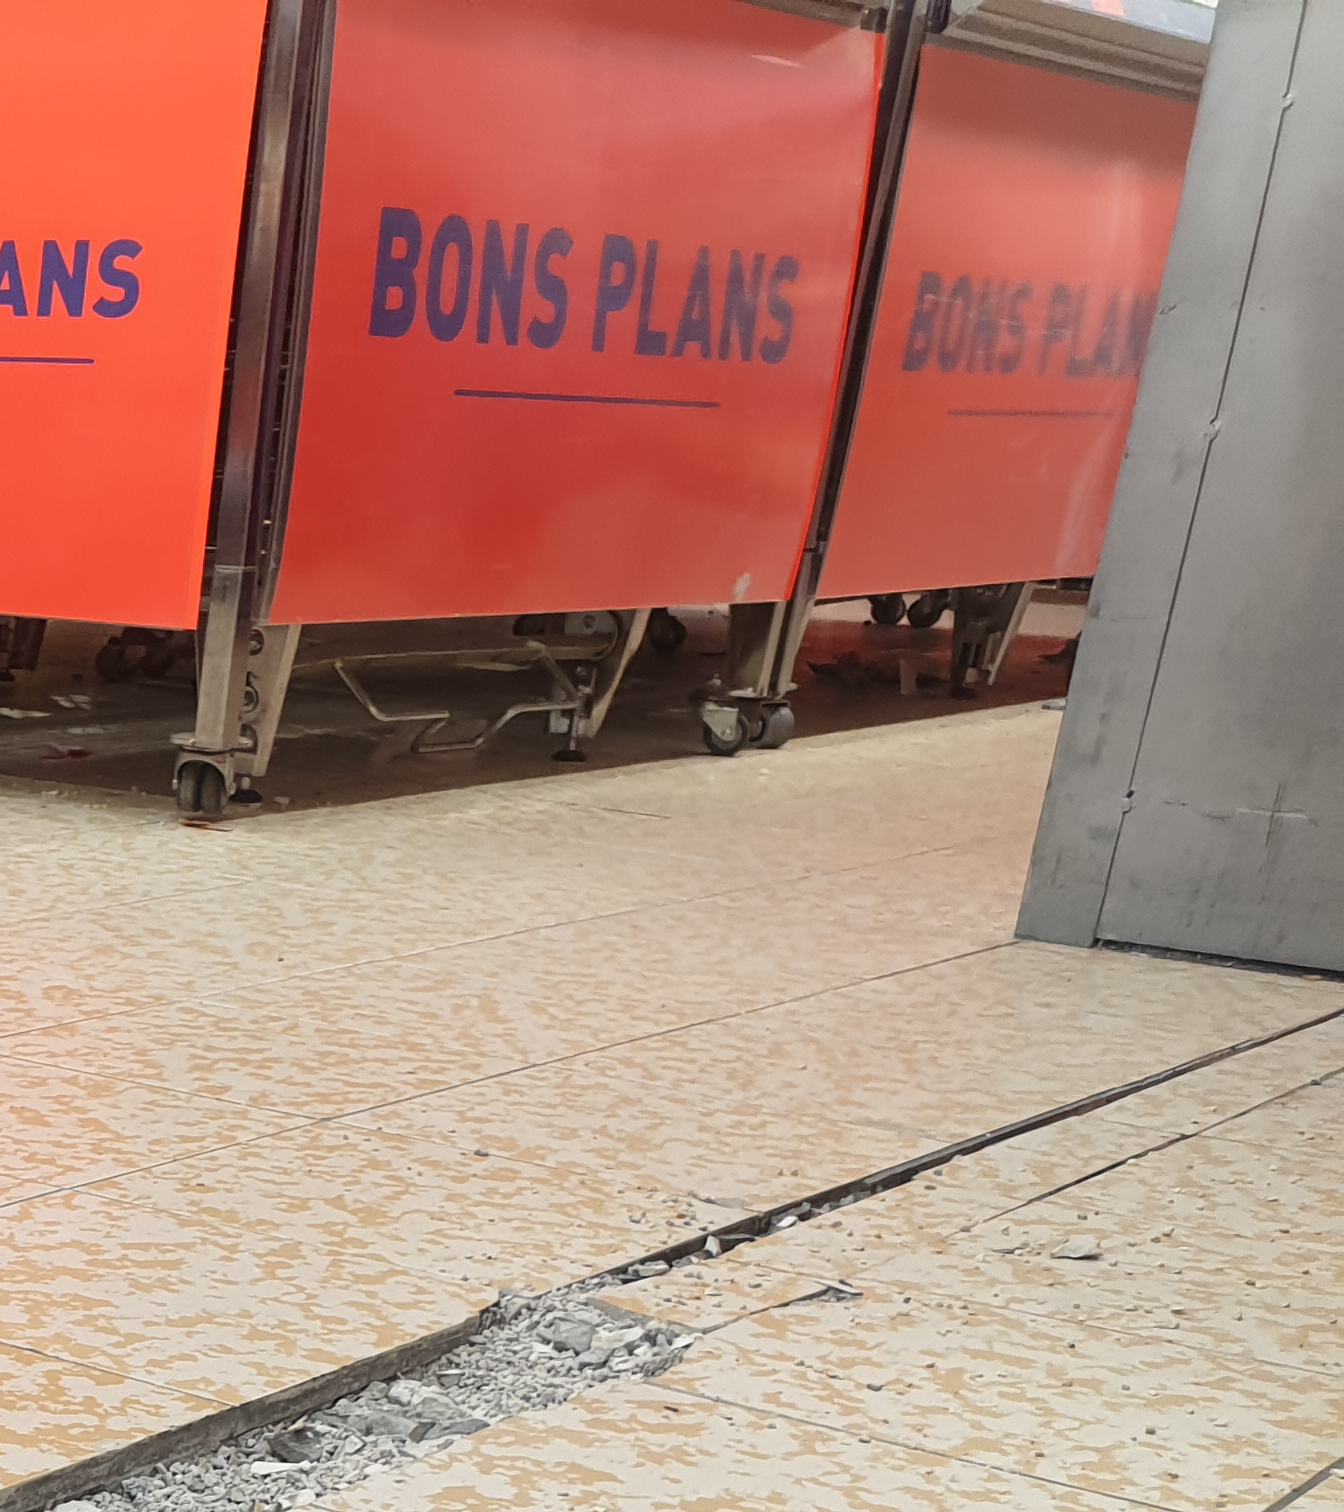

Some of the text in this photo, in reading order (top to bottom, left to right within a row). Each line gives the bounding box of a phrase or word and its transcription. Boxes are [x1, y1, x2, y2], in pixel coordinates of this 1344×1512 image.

[369, 206, 800, 365] BONS PLANS
[901, 271, 1160, 378] BONS PLAN
